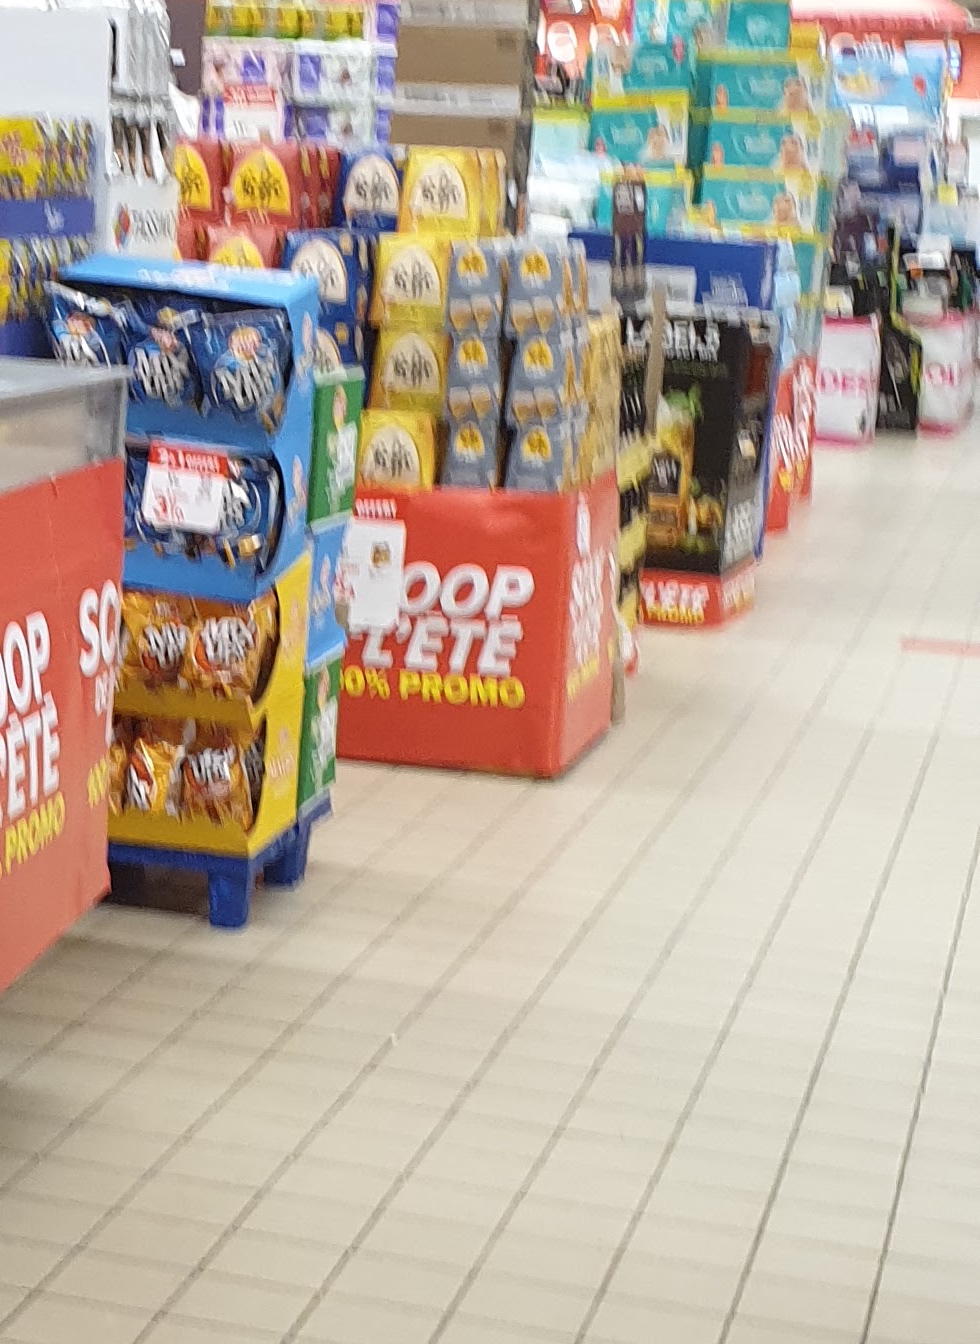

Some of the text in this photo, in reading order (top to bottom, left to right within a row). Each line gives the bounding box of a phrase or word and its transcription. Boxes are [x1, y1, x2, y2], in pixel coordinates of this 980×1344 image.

[399, 560, 535, 622] OOP
[341, 665, 526, 708] 0% PROMO
[5, 792, 66, 874] PROMO
